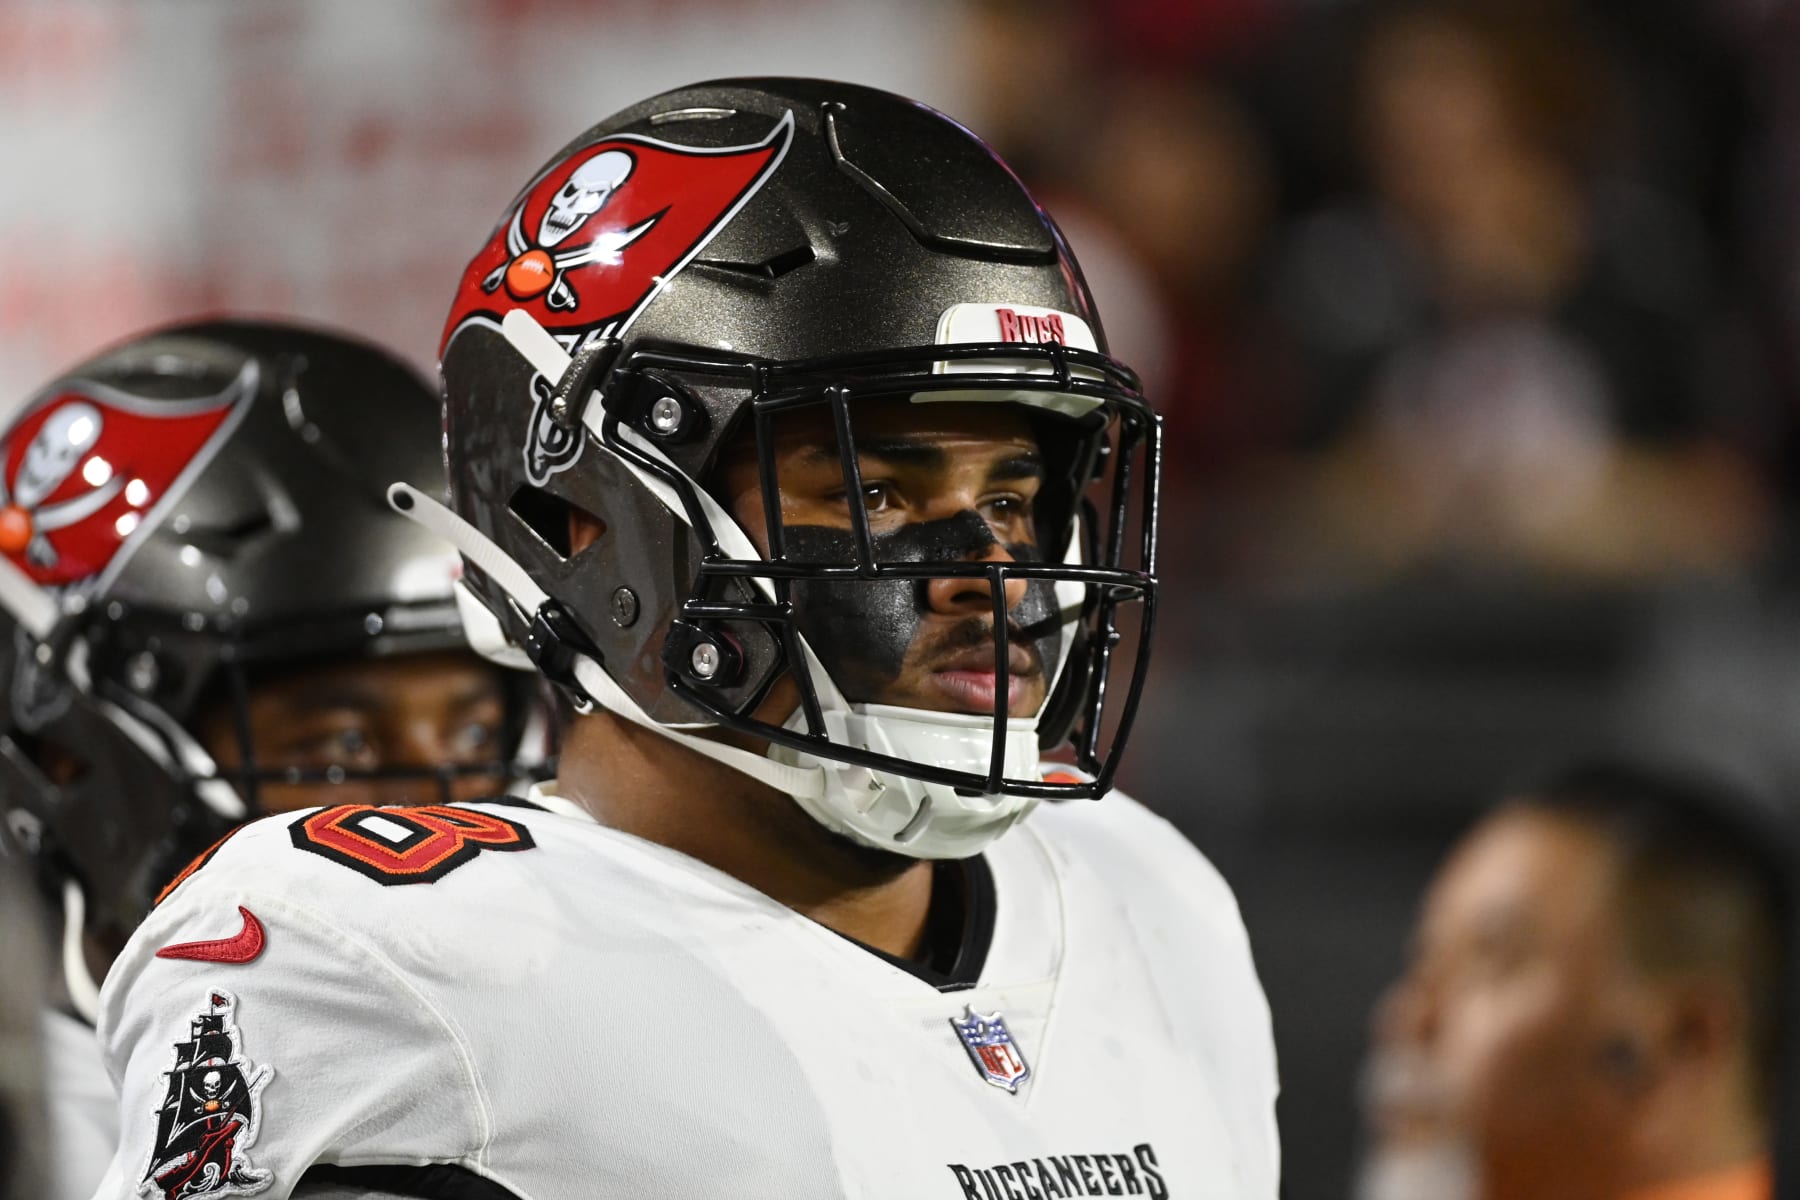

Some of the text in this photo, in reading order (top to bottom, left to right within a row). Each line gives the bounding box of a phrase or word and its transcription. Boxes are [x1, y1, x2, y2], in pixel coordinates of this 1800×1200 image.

[995, 309, 1066, 346] BUCS
[287, 803, 537, 887] 8
[976, 1044, 1023, 1079] NFL
[946, 1143, 1170, 1200] BUCCANEERS
